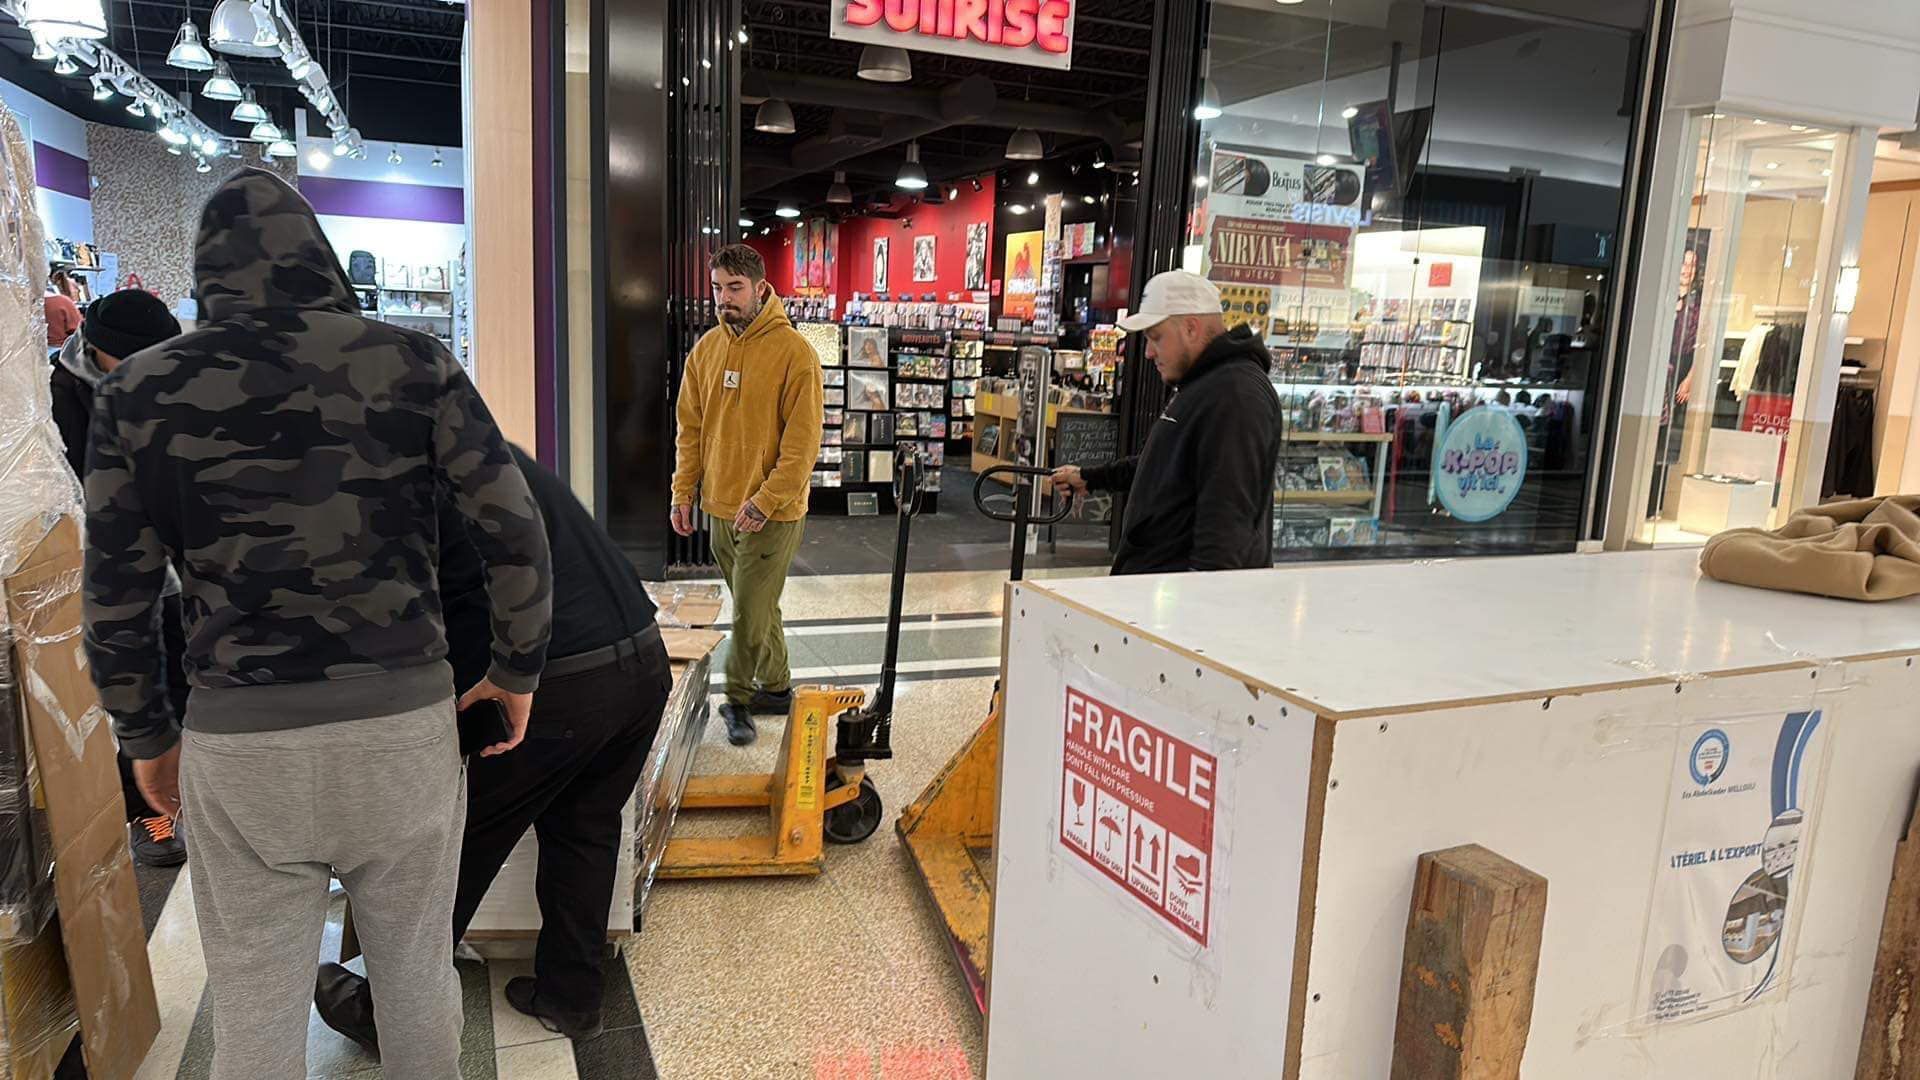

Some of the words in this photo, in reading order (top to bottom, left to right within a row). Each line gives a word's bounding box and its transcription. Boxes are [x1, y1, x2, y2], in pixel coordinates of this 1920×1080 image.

[1214, 231, 1291, 268] NIRVANA
[1230, 269, 1240, 279] IN
[1066, 739, 1093, 759] HANDLE
[1092, 752, 1111, 770] WITH
[1111, 763, 1131, 783] CARE
[1068, 693, 1213, 810] FRAGILE
[1084, 763, 1100, 781] FALL
[1101, 773, 1116, 790] NOT
[1116, 781, 1155, 813] PRESSURE
[1718, 842, 1762, 861] L'EXPORT
[1131, 875, 1159, 901] UPWARD
[1169, 902, 1200, 930] TRAMPLE
